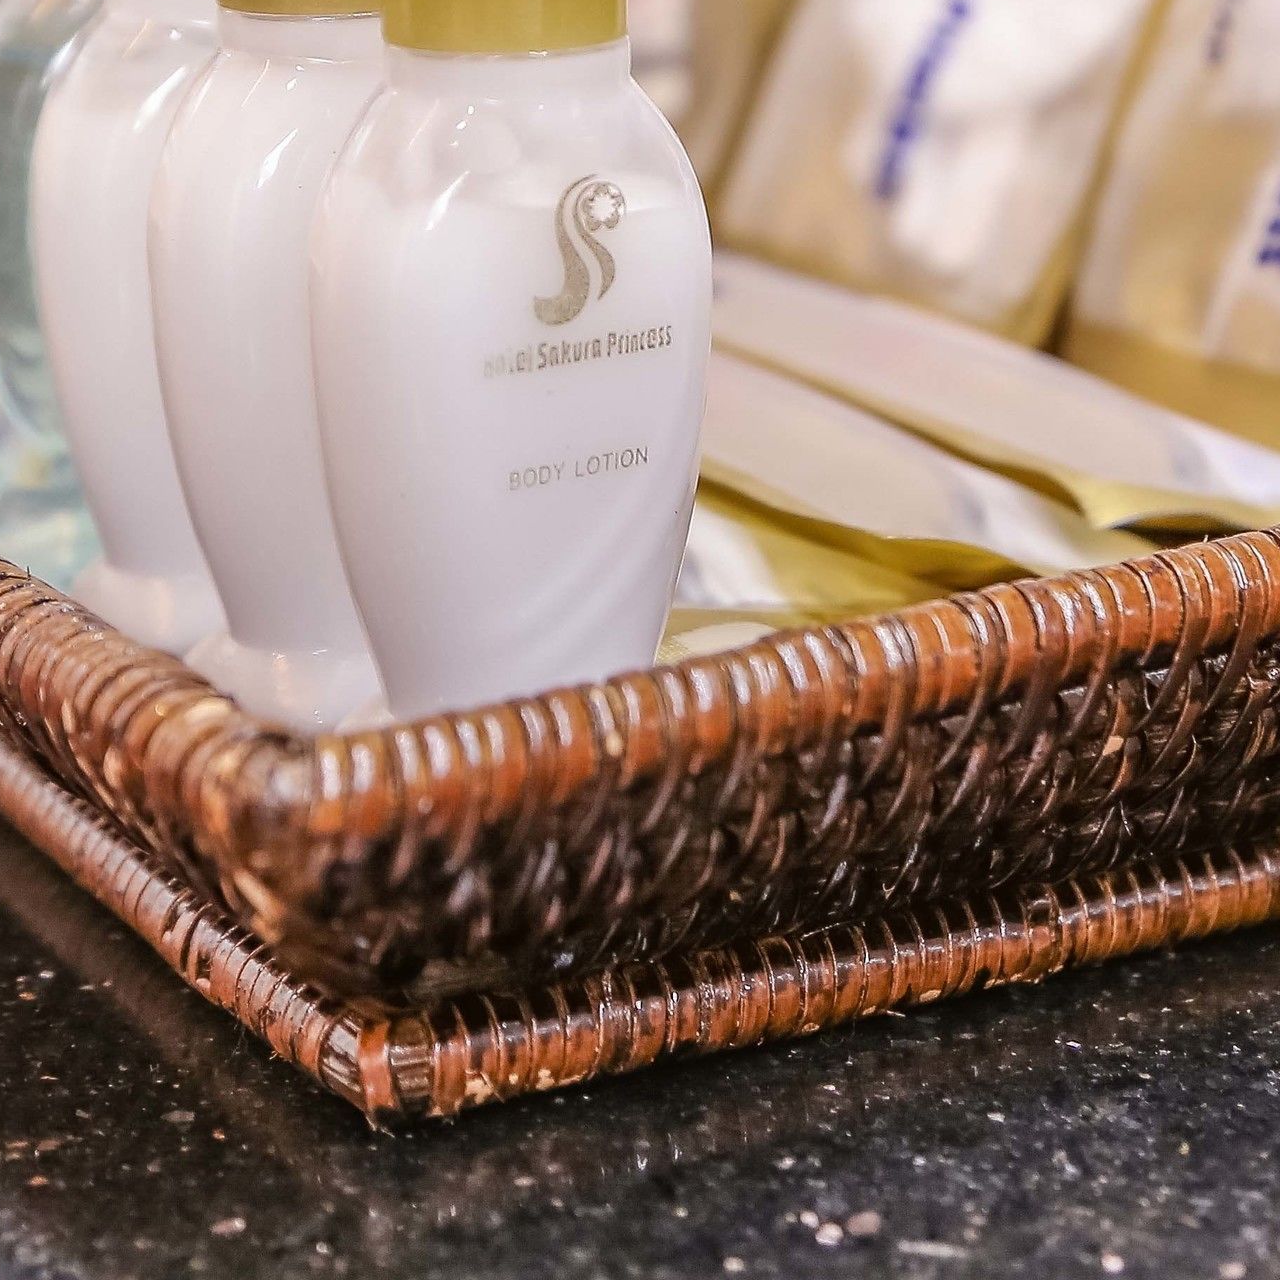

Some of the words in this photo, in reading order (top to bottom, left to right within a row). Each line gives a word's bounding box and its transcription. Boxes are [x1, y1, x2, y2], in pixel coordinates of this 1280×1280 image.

[537, 336, 601, 369] Sakura
[607, 324, 673, 358] Princess
[508, 462, 565, 491] BODY
[575, 447, 649, 477] LOTION
